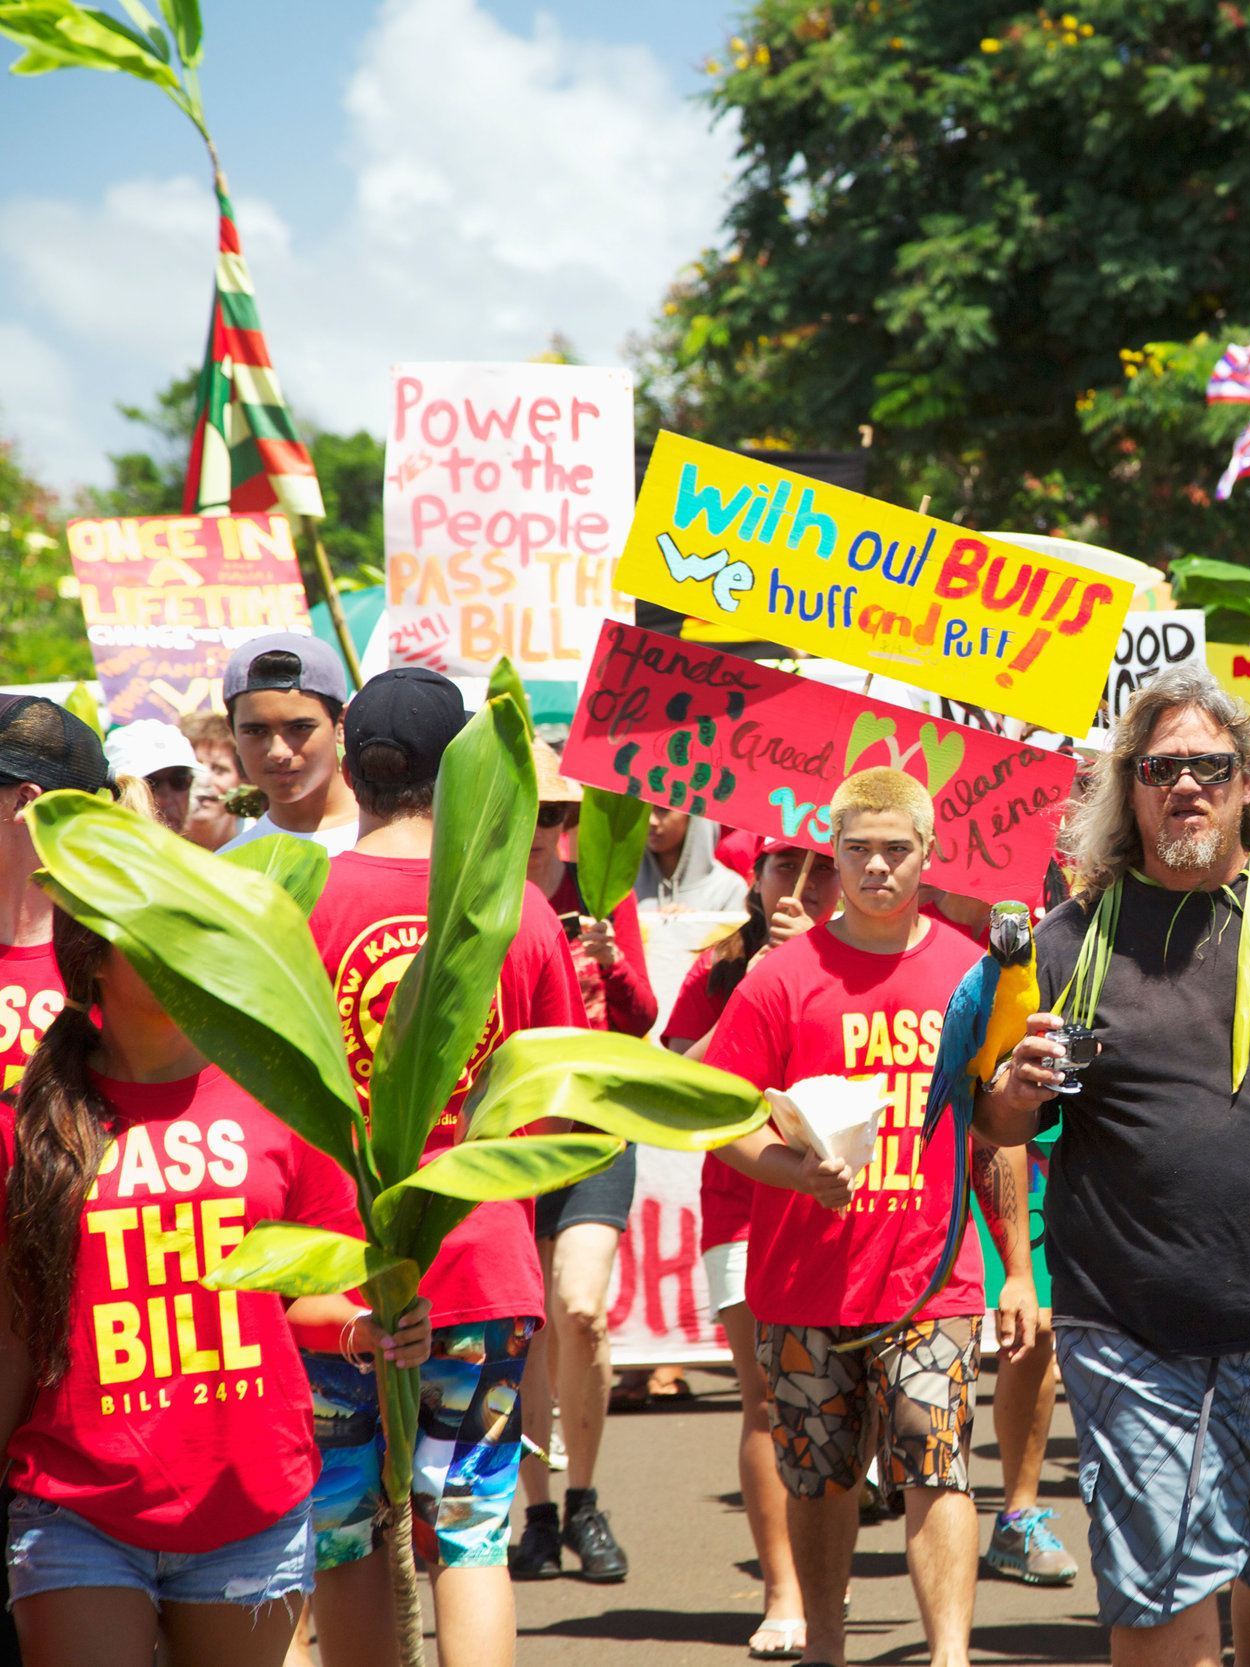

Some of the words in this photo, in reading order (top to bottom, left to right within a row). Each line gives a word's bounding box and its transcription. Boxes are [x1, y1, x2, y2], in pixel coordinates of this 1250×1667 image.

[394, 376, 600, 447] Power
[438, 446, 501, 493] to
[511, 444, 594, 495] the
[67, 517, 207, 563] ONCE
[217, 516, 297, 561] IN
[412, 494, 610, 568] People
[673, 462, 838, 561] With
[80, 583, 313, 628] LIFETIME
[389, 549, 518, 606] PASS
[768, 567, 858, 629] huff
[858, 602, 943, 646] and
[389, 614, 449, 654] 2491
[461, 602, 582, 662] BILL
[596, 626, 761, 690] Hands
[729, 720, 838, 781] Greed
[842, 1009, 944, 1069] PASS
[848, 1072, 933, 1128] HE
[87, 1197, 245, 1290] THE
[93, 1290, 262, 1384] BILL
[101, 1391, 171, 1415] BILL
[194, 1377, 264, 1405] 2491
